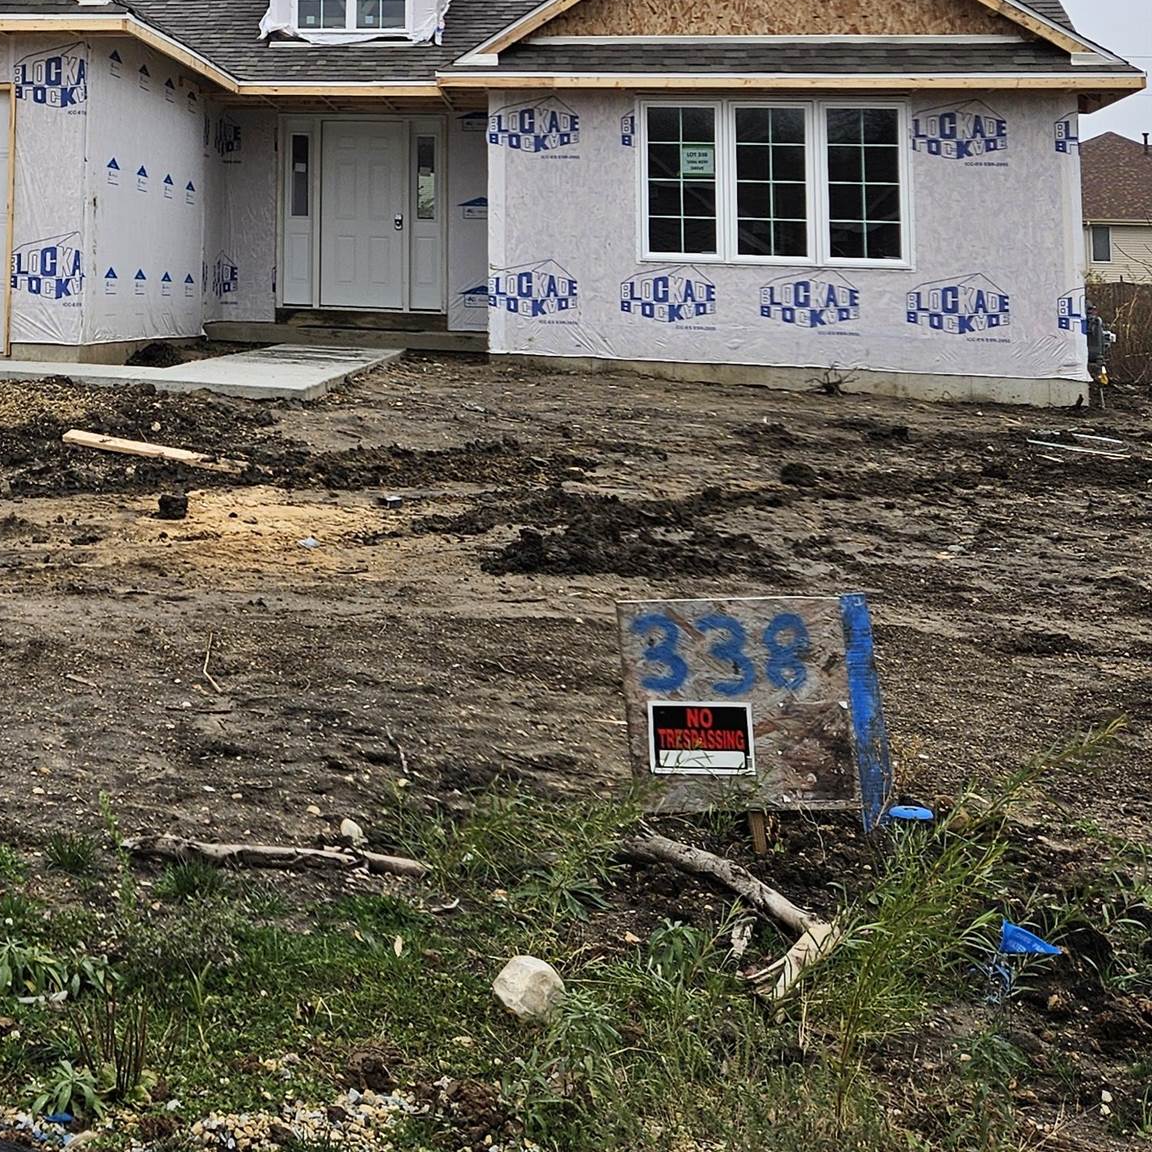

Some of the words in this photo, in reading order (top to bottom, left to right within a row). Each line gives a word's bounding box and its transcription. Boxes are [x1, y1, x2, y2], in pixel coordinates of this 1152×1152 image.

[488, 108, 580, 134] BLOCKADE
[912, 112, 1007, 140] LOCKADE
[488, 271, 577, 298] BLOCKADE
[621, 275, 715, 303] BLOCKADE
[759, 279, 859, 308] BLOCKADE
[906, 285, 1009, 315] BLOCKADE
[632, 612, 809, 696] 338
[686, 708, 714, 728] NO
[657, 728, 746, 751] TRESPASSING
